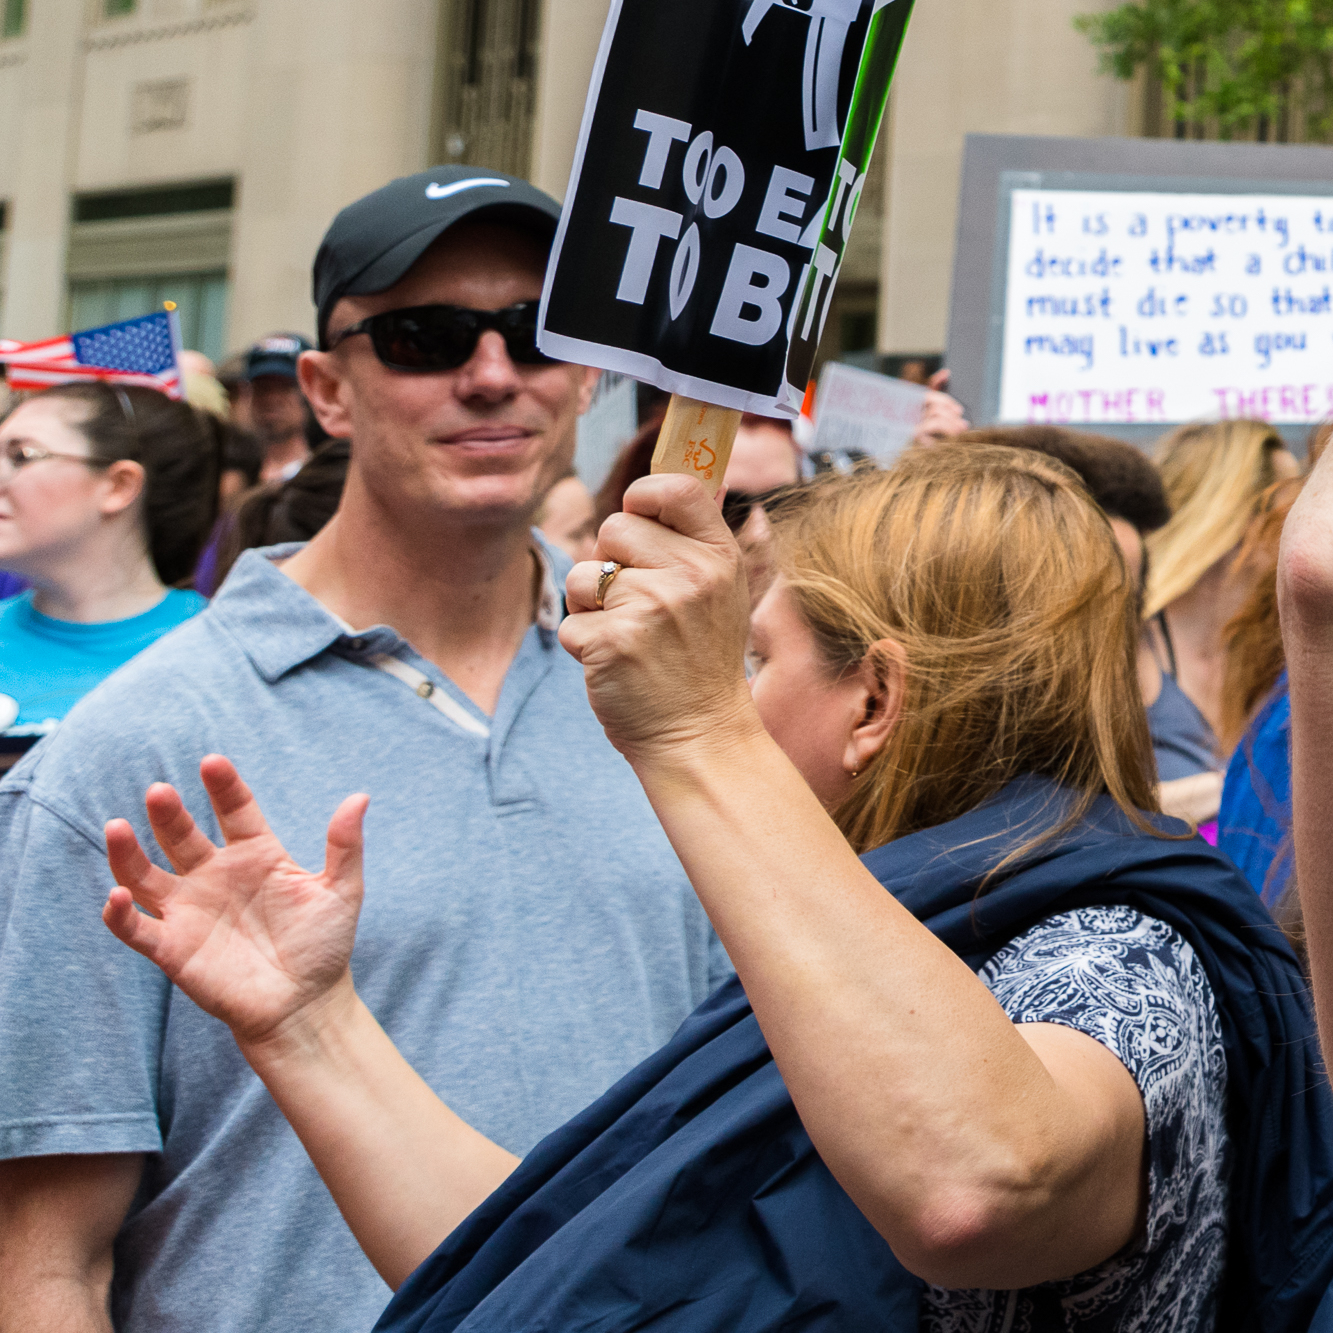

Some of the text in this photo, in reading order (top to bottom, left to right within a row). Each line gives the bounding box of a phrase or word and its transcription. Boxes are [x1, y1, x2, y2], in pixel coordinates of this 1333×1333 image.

[634, 109, 745, 219] TOO
[1033, 201, 1055, 234] It
[1082, 211, 1109, 236] is
[1127, 212, 1148, 237] a
[1166, 207, 1289, 248] poverty
[610, 196, 700, 321] TO
[1025, 247, 1121, 279] decide
[1150, 246, 1217, 275] that
[1245, 252, 1262, 275] a
[1026, 287, 1111, 318] must
[1137, 287, 1189, 317] die
[1211, 293, 1247, 317] so
[1272, 284, 1331, 315] that
[1025, 334, 1094, 372] may
[1120, 325, 1179, 357] live
[1198, 331, 1229, 356] as
[1254, 332, 1307, 369] you
[1028, 388, 1166, 424] MOTHER
